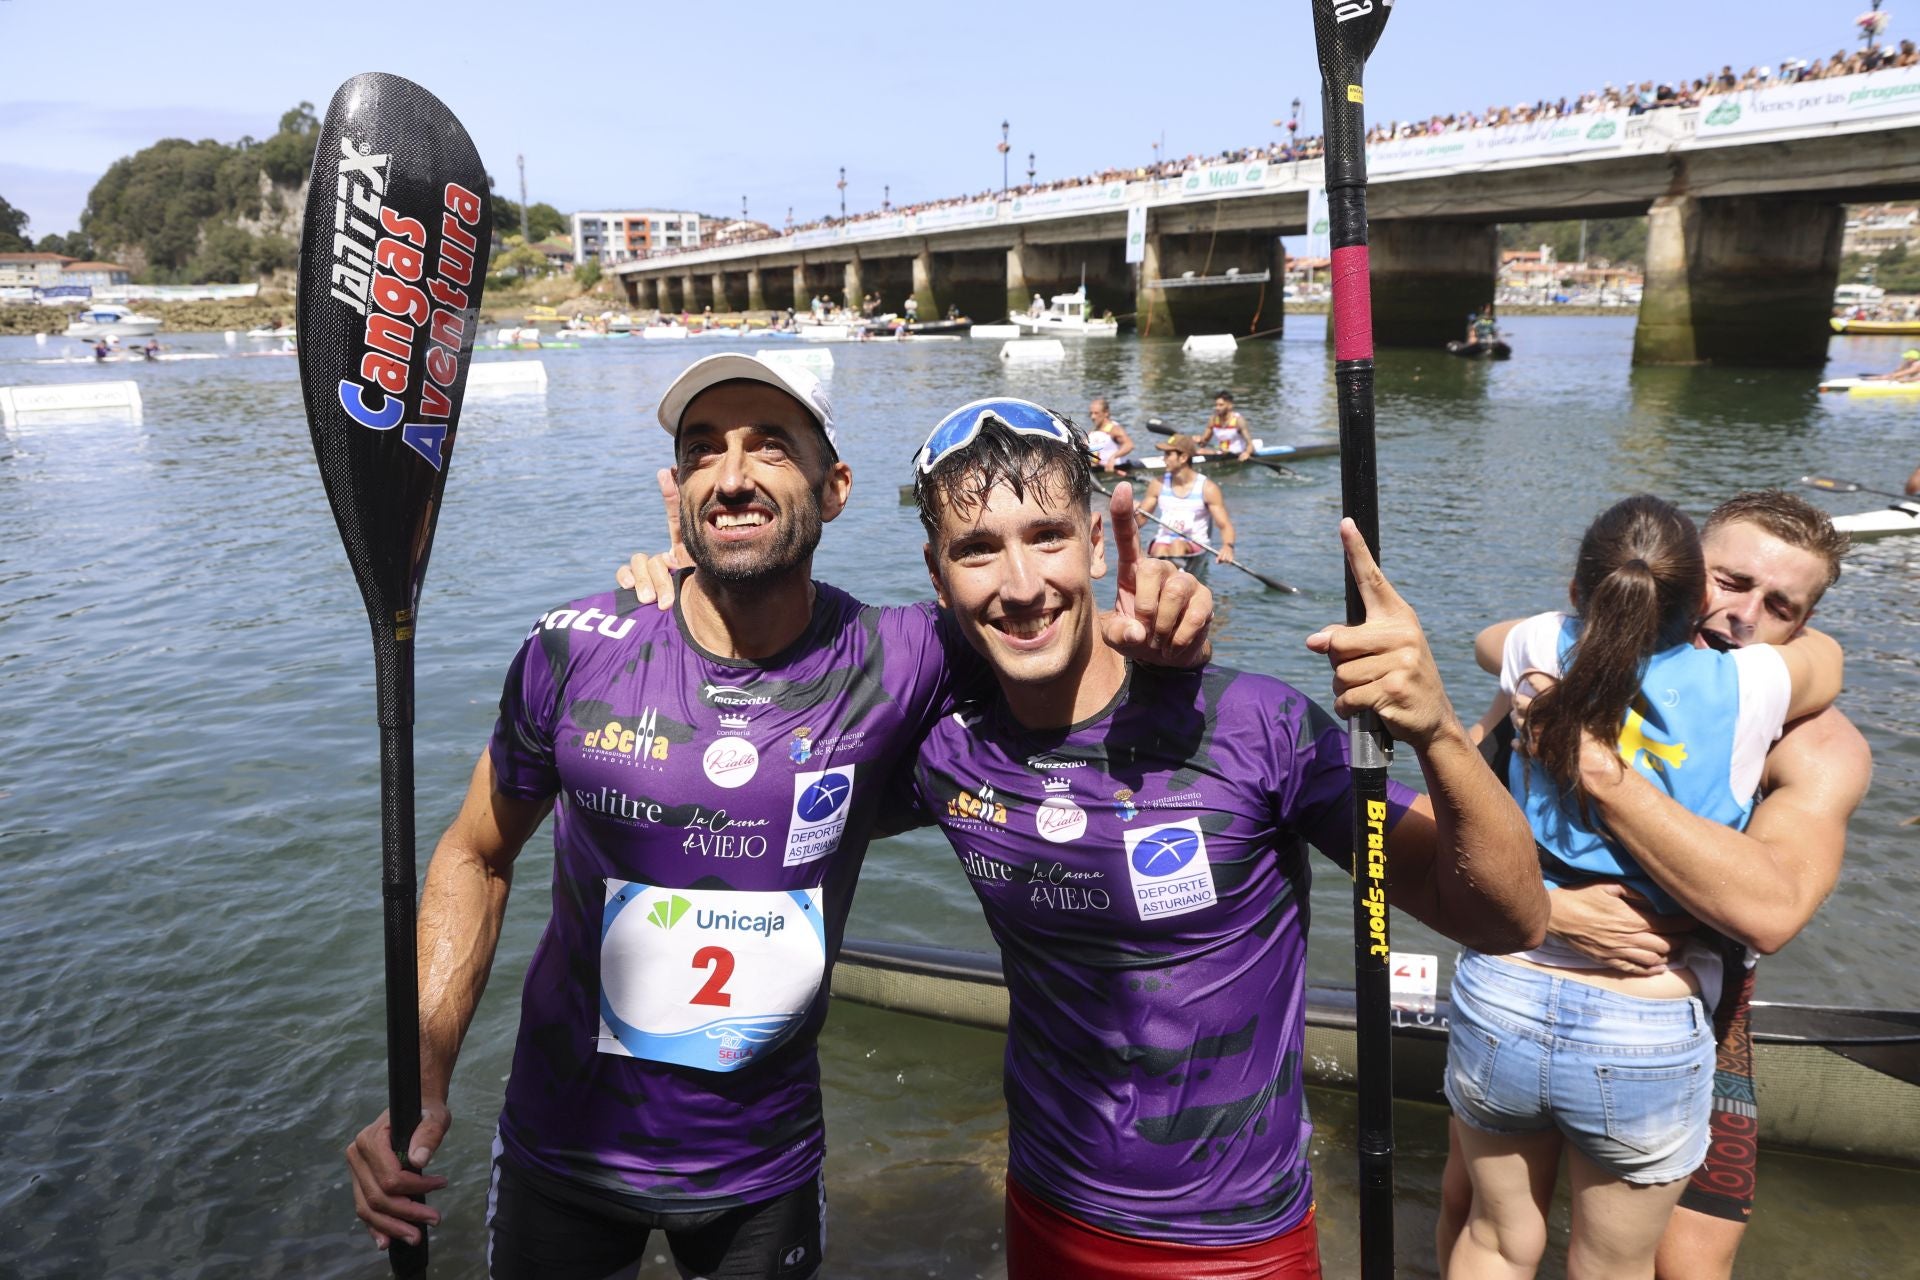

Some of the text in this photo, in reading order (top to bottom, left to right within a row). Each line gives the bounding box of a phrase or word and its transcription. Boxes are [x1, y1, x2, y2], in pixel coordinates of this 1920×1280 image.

[338, 206, 430, 431] Cangas
[402, 182, 482, 472] Aventura
[818, 731, 865, 748] Ayuntmiento
[706, 749, 756, 771] Rialto
[575, 786, 663, 823] salitre
[684, 808, 770, 833] La Casona
[682, 833, 767, 858] de VIEJO
[790, 823, 843, 844] DEPORTE
[788, 836, 840, 857] ASTURIANO
[961, 851, 1013, 881] alitre
[1028, 862, 1048, 884] La
[1048, 862, 1105, 885] Casona
[1030, 887, 1110, 910] de VIEJO
[1137, 877, 1208, 900] DEPORTE
[1143, 890, 1211, 913] ASTURIANO
[696, 909, 785, 938] Unicaja
[688, 945, 736, 1008] 2
